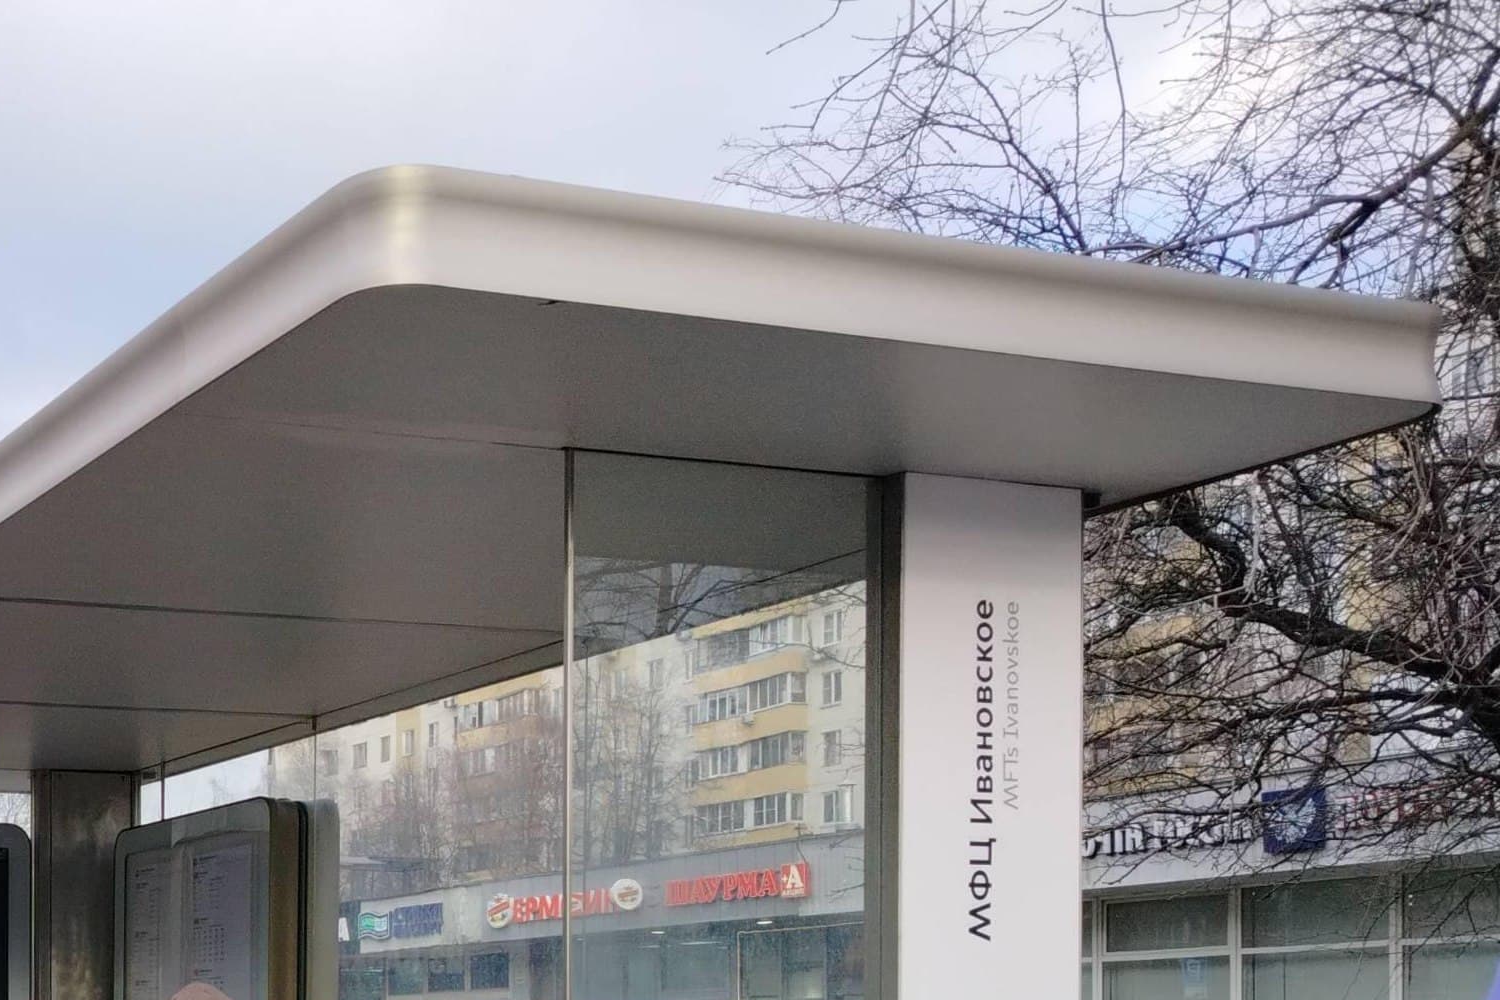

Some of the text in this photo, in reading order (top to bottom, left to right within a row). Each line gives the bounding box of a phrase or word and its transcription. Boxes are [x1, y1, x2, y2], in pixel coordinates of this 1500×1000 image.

[967, 599, 996, 942] МФЦ Ивановское
[1002, 600, 1019, 811] MFTs Ivanovskoe
[665, 868, 778, 906] ШАУРМА
